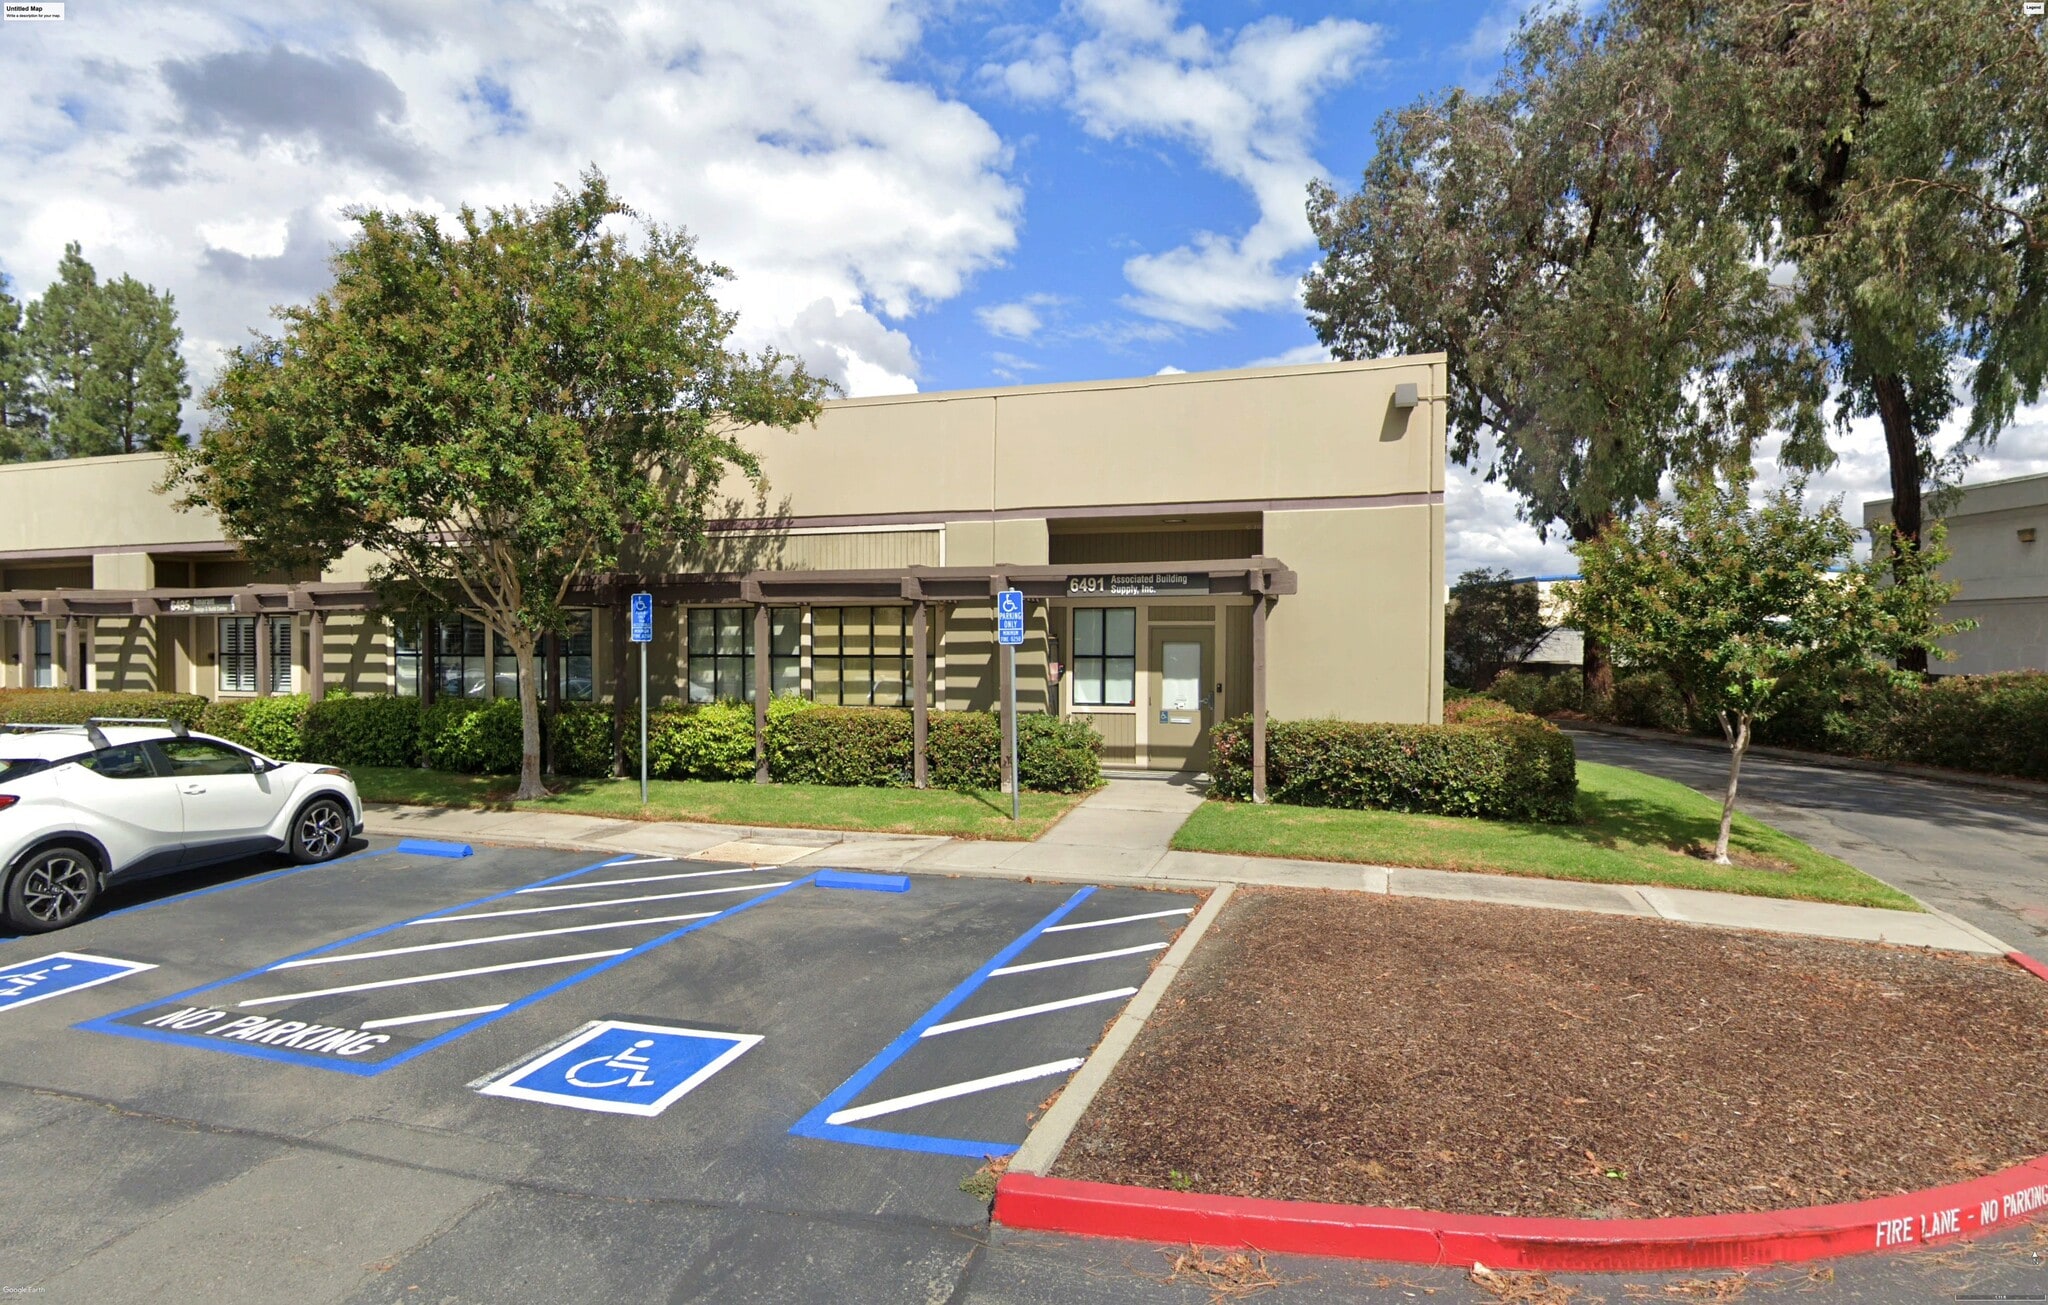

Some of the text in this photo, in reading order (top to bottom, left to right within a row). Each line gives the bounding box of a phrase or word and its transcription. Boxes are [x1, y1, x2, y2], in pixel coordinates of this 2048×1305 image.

[1070, 577, 1105, 593] 6491
[1110, 574, 1188, 585] Associated Building
[1110, 584, 1157, 595] Supply, Inc.
[170, 600, 191, 612] 6495
[999, 612, 1022, 620] PARKING
[1003, 620, 1018, 628] ONLY
[143, 1007, 391, 1056] NO PARKING
[1875, 1216, 1914, 1247] FIRE
[1920, 1208, 1961, 1238] LANE
[1980, 1199, 1999, 1226] NO
[2003, 1184, 2048, 1218] PARKING
